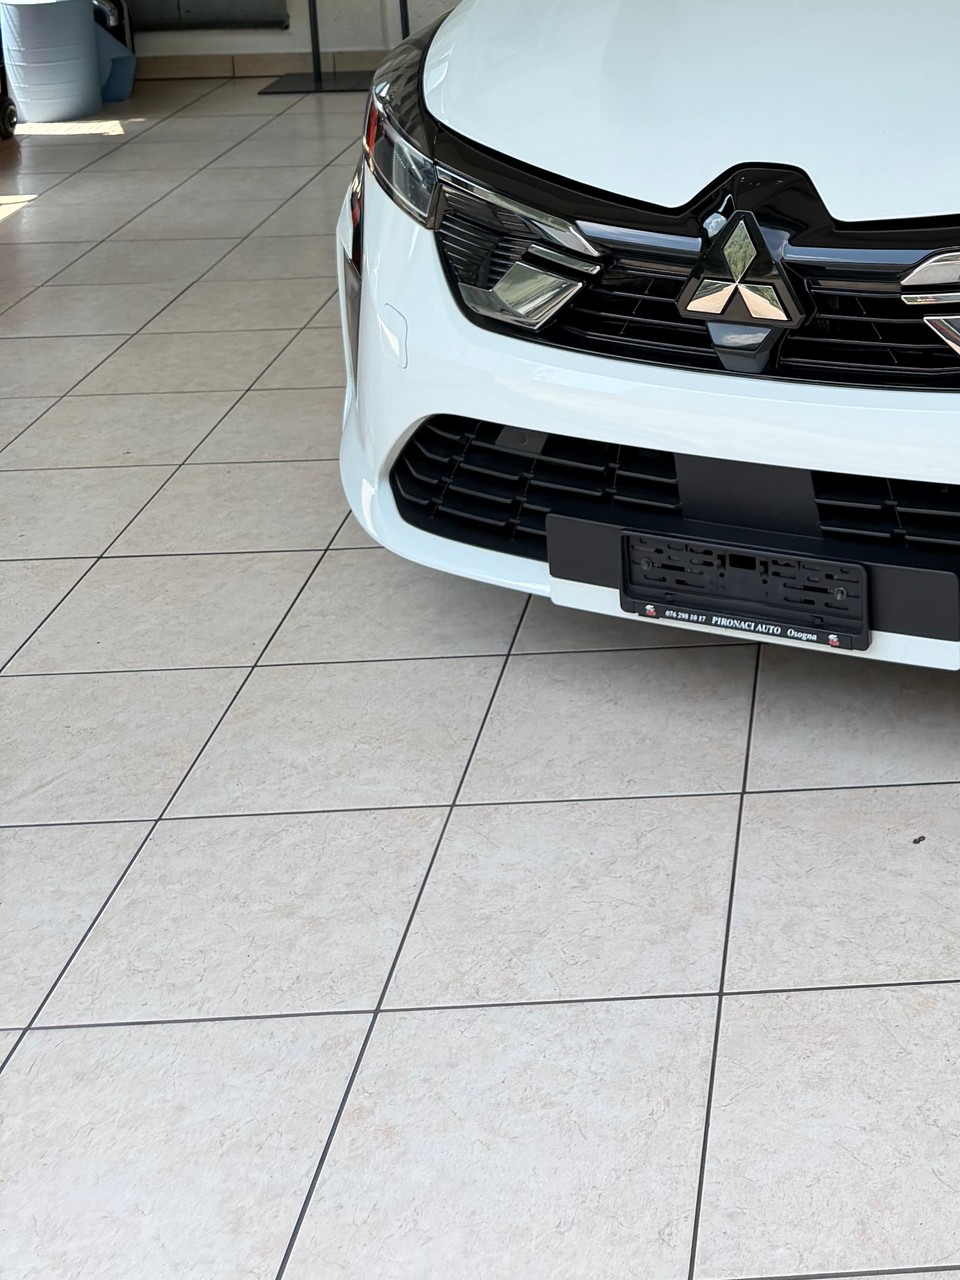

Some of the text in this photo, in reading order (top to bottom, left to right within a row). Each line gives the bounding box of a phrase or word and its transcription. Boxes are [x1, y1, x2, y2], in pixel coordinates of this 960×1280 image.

[665, 610, 677, 618] 076
[678, 612, 689, 620] 298
[690, 614, 698, 622] 10
[712, 616, 754, 630] PIRONACI
[756, 625, 781, 634] AUTO
[787, 629, 817, 641] Osogna
